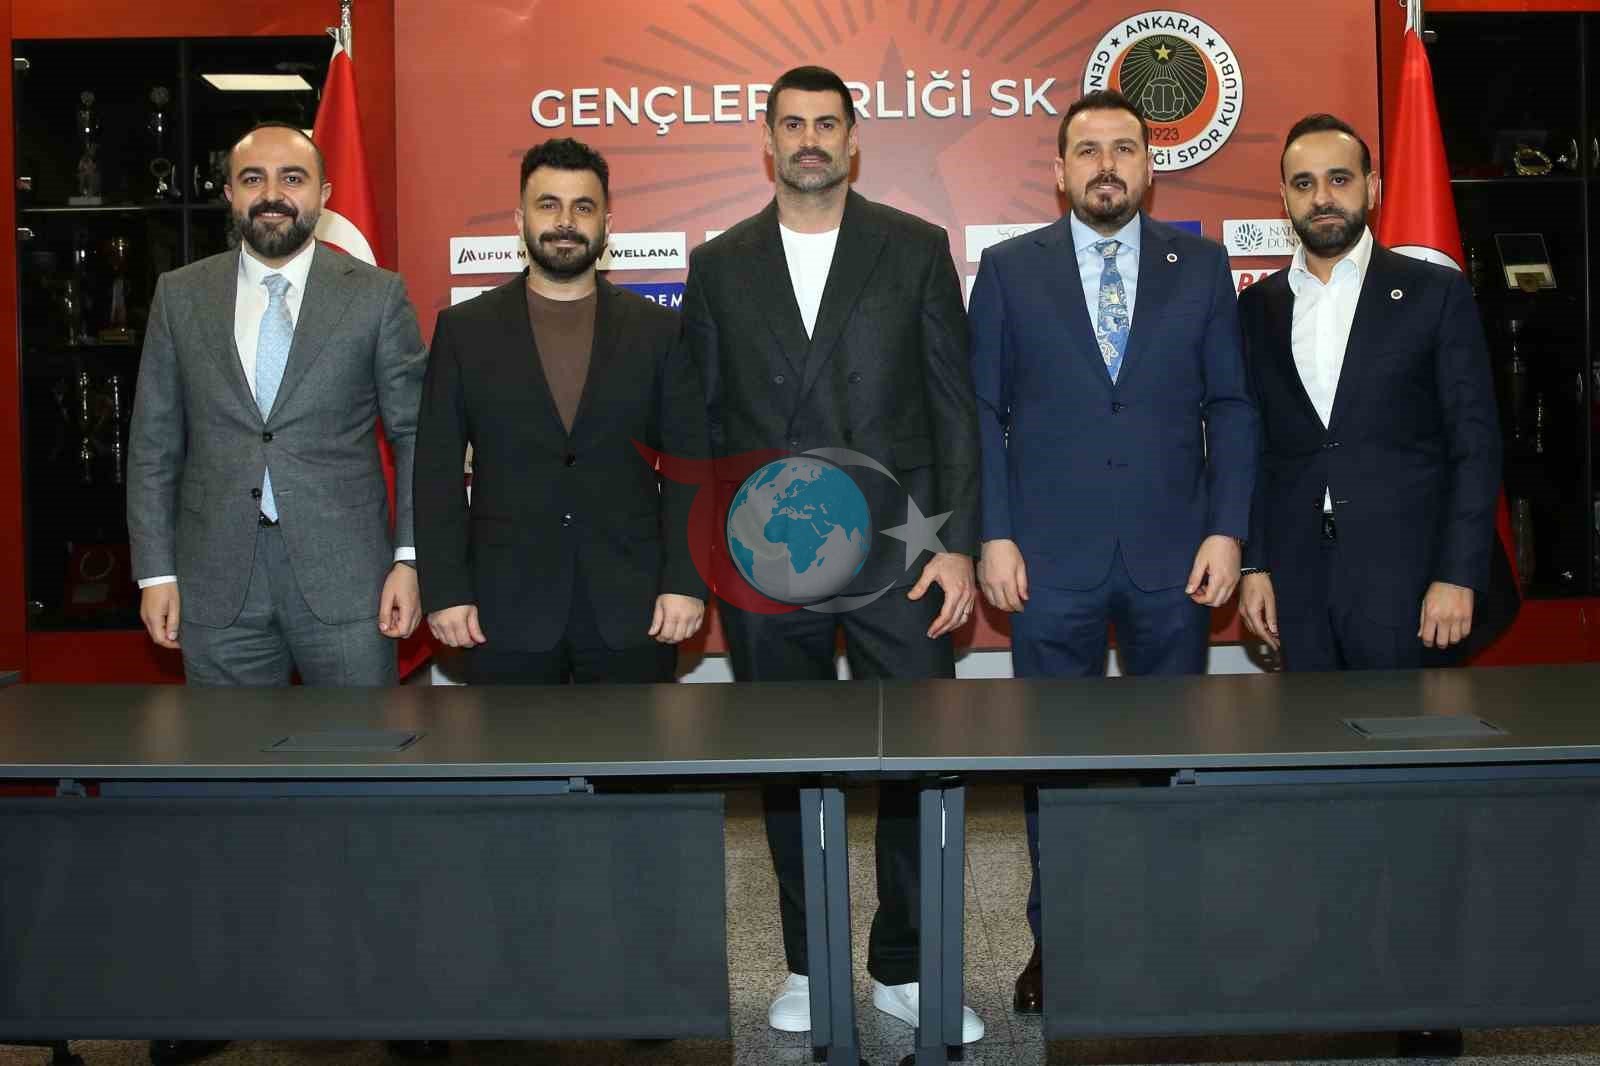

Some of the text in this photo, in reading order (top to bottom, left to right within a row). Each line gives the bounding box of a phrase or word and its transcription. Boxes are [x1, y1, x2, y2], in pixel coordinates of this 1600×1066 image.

[1125, 15, 1201, 39] ANKARA
[530, 69, 1058, 135] GENÇLERRLİĞİ SK
[1177, 51, 1238, 163] SPOR KULÜBÜ
[478, 251, 512, 261] UFUK
[609, 248, 679, 258] WELLANA
